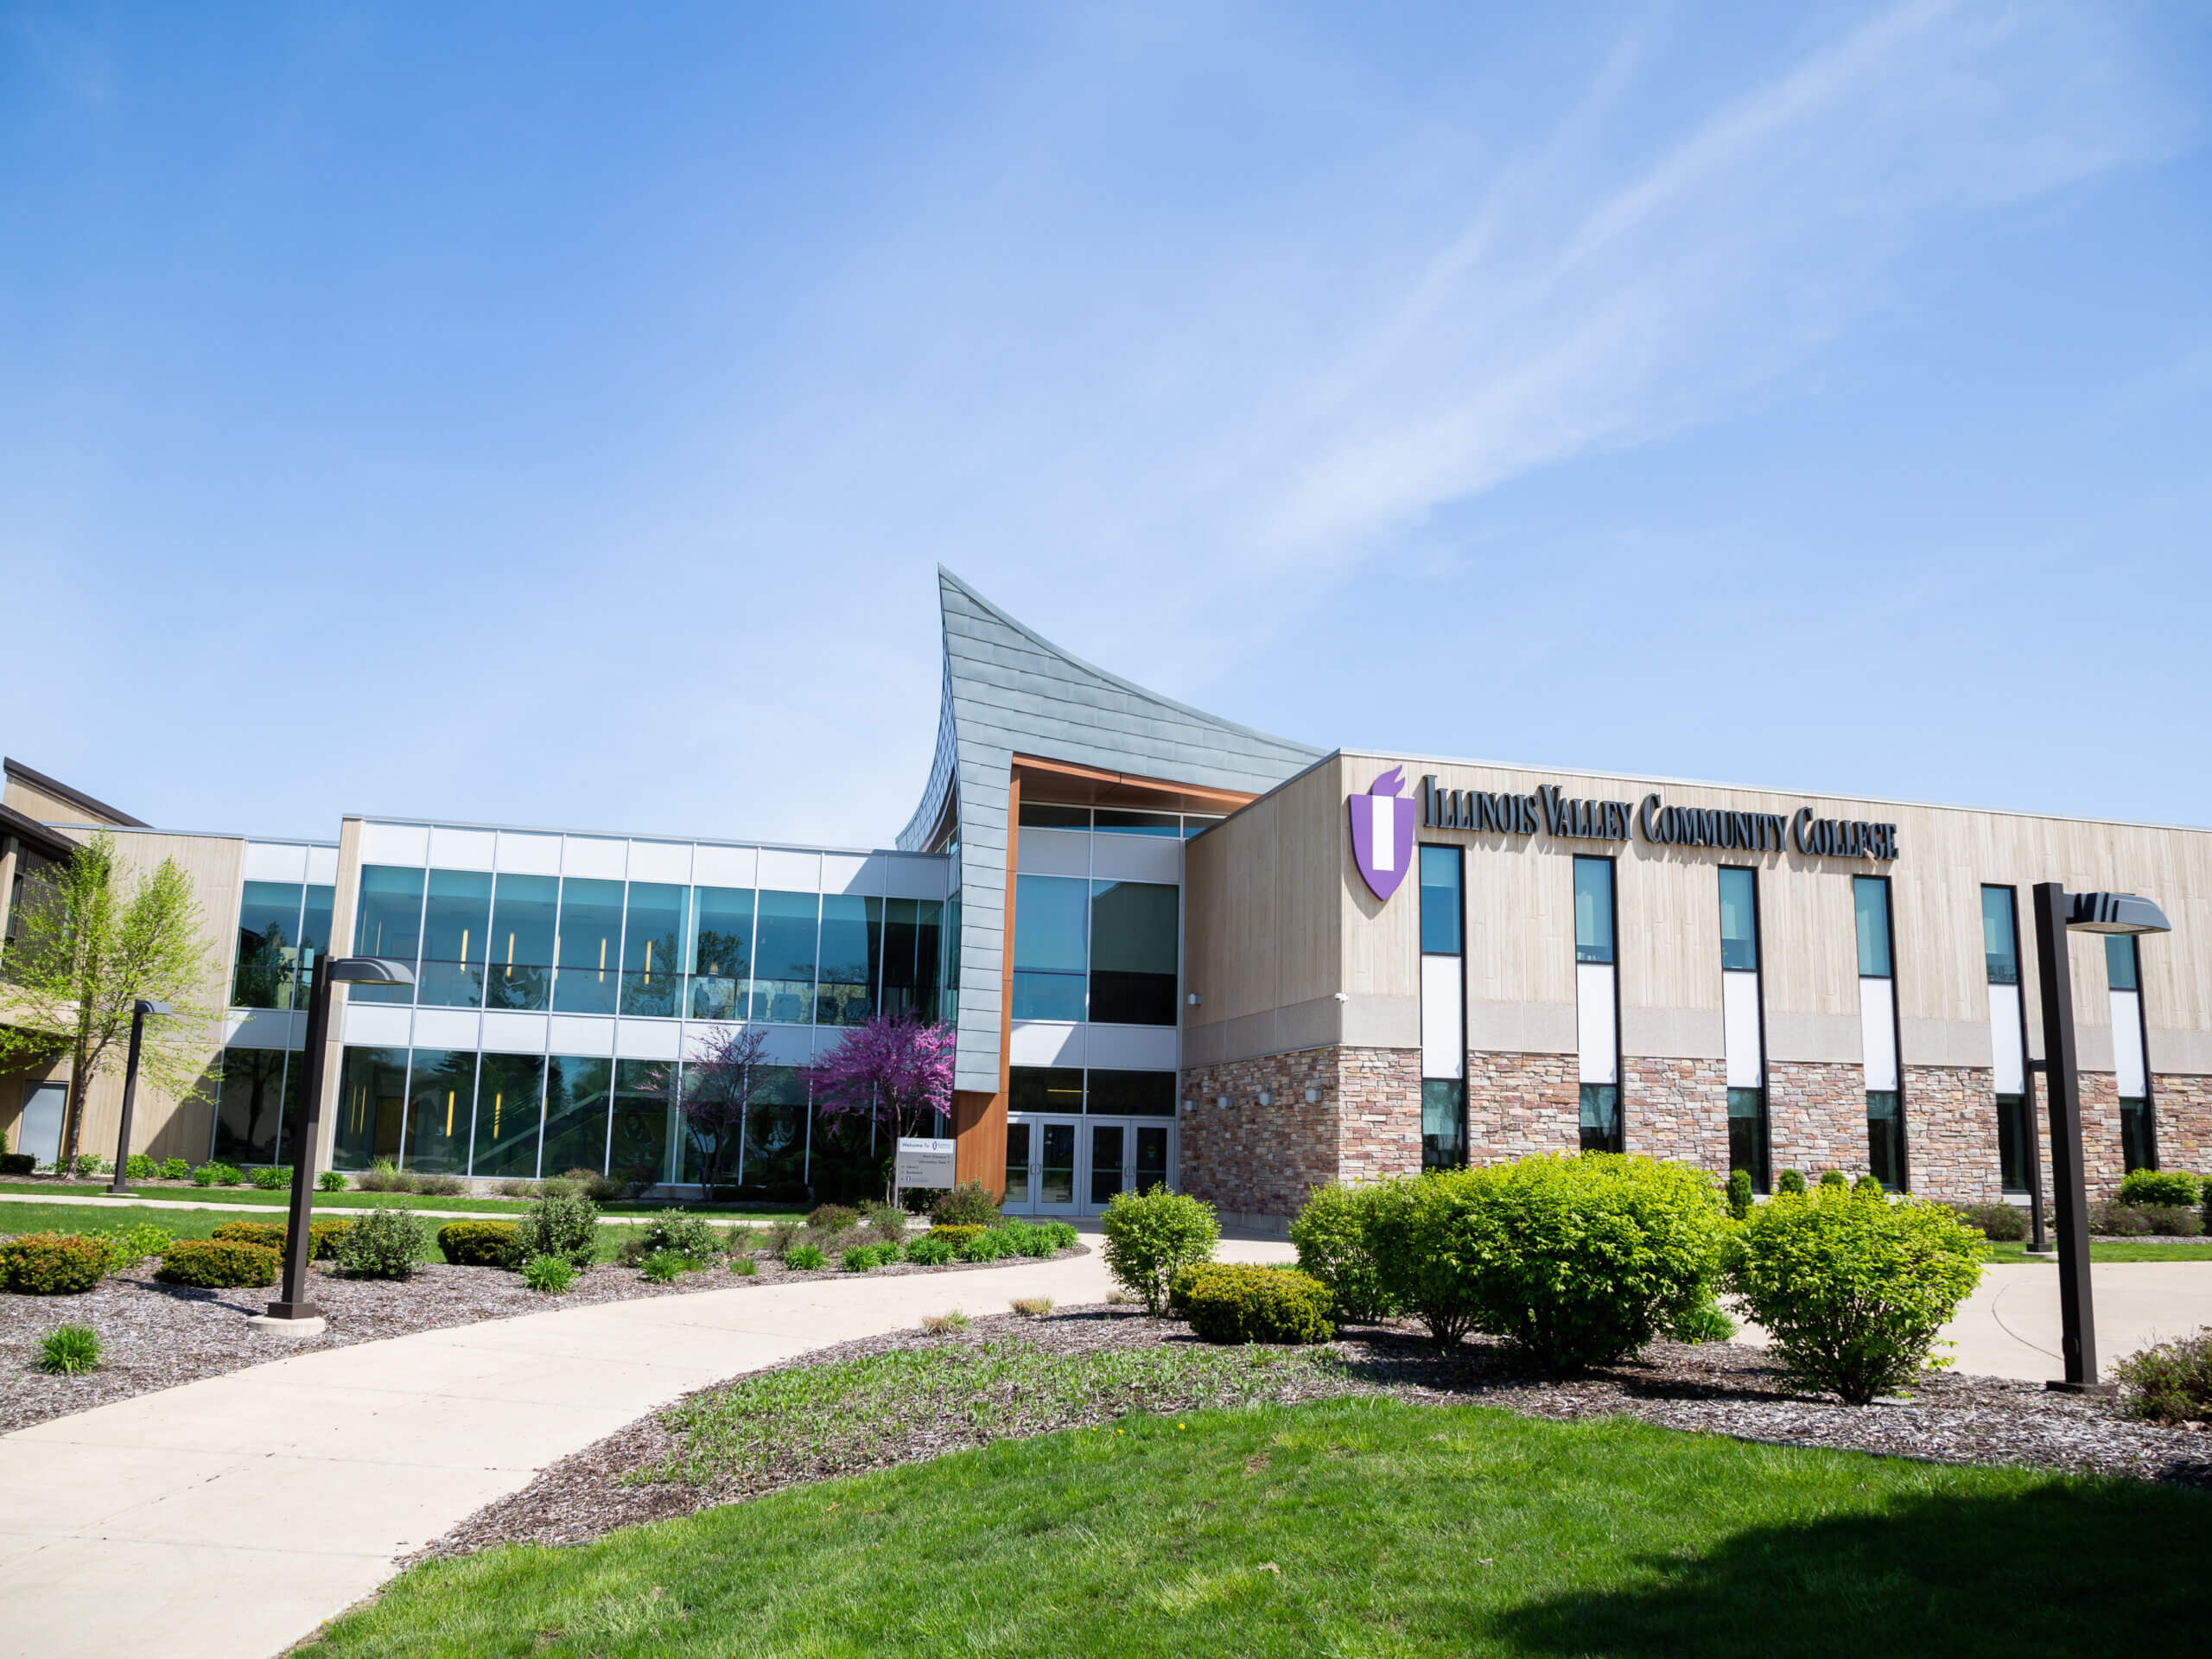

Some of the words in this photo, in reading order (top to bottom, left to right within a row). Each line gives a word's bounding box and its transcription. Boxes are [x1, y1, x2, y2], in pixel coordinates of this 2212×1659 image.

[1424, 775, 1540, 835] ILLINOIS
[1538, 785, 1634, 842] VALLEY
[1642, 793, 1789, 852] COMMUNITY
[1794, 806, 1899, 860] COLLEGE
